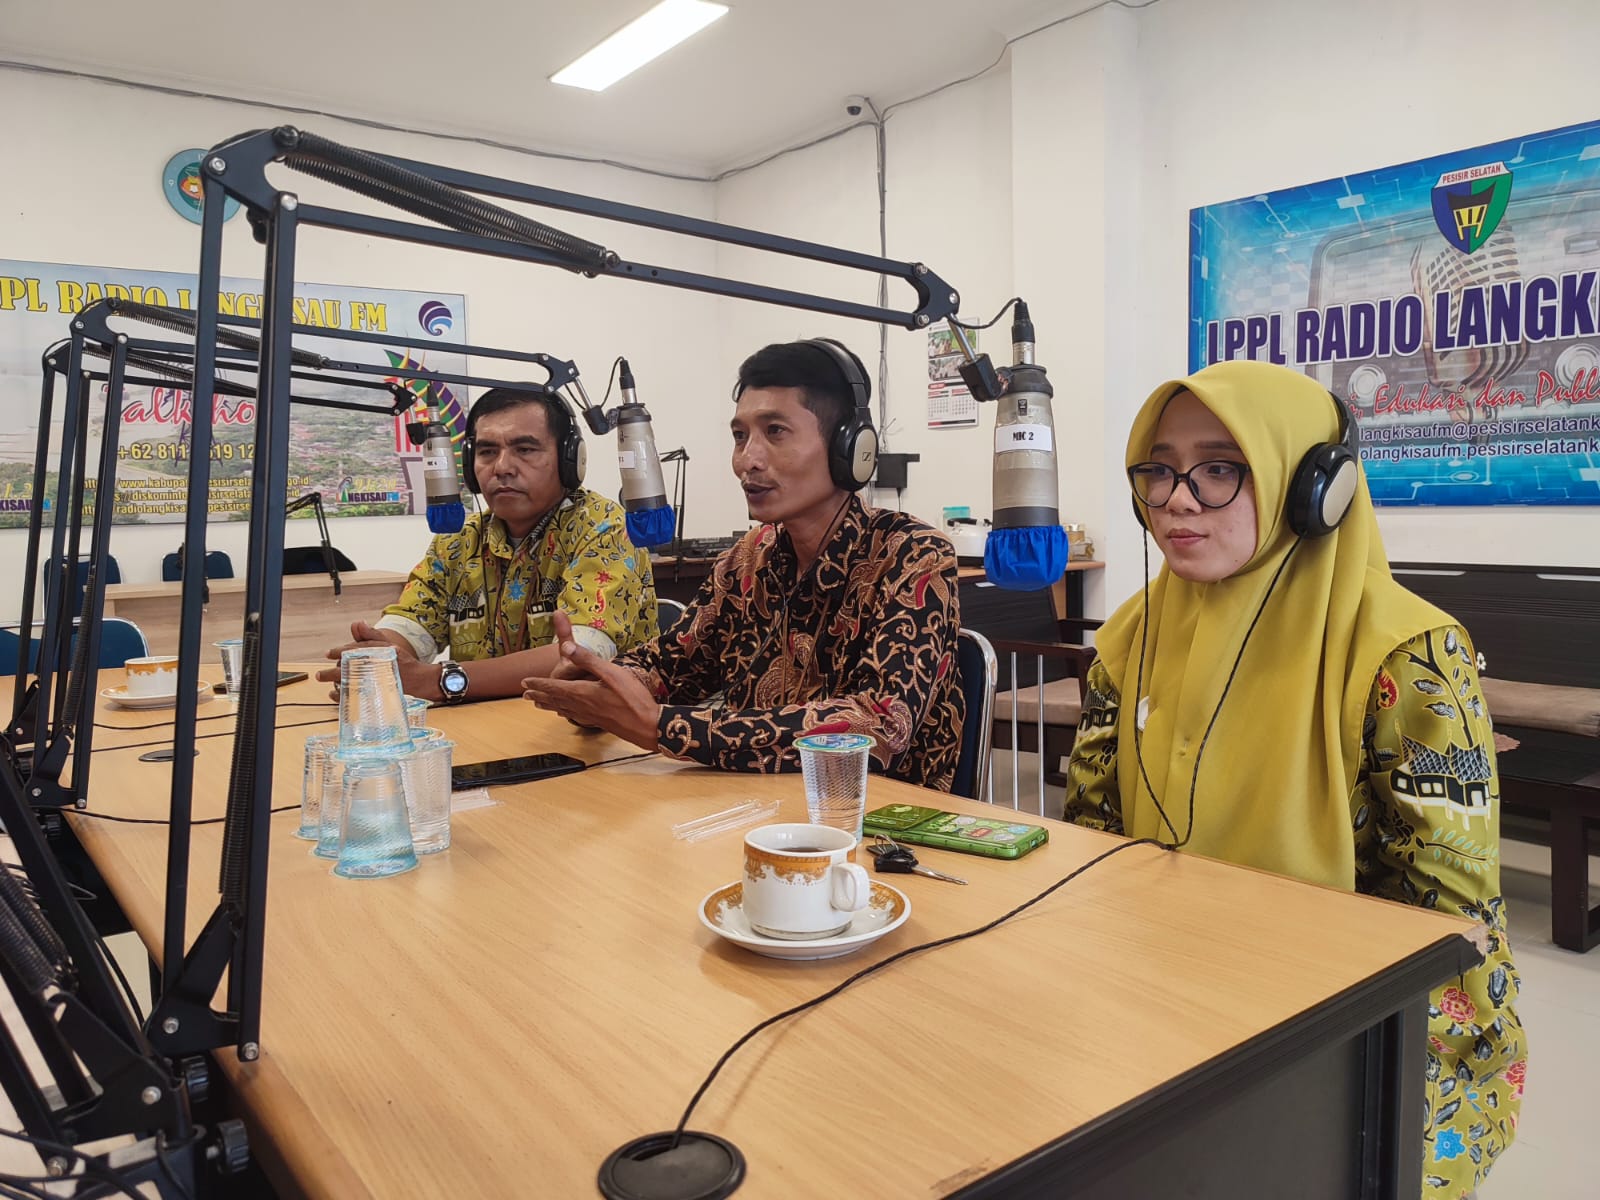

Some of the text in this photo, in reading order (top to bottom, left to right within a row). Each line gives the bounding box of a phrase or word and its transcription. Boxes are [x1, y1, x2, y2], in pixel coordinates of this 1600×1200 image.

[1442, 163, 1501, 184] PESISIR SELATAN
[350, 301, 388, 332] FM
[1207, 314, 1287, 365] LPPL
[1295, 294, 1424, 363] RADIO
[1374, 383, 1468, 415] Edukasi
[1474, 377, 1527, 409] dan
[1012, 431, 1034, 441] MIC 2
[118, 443, 152, 460] +62
[157, 443, 187, 459] 811
